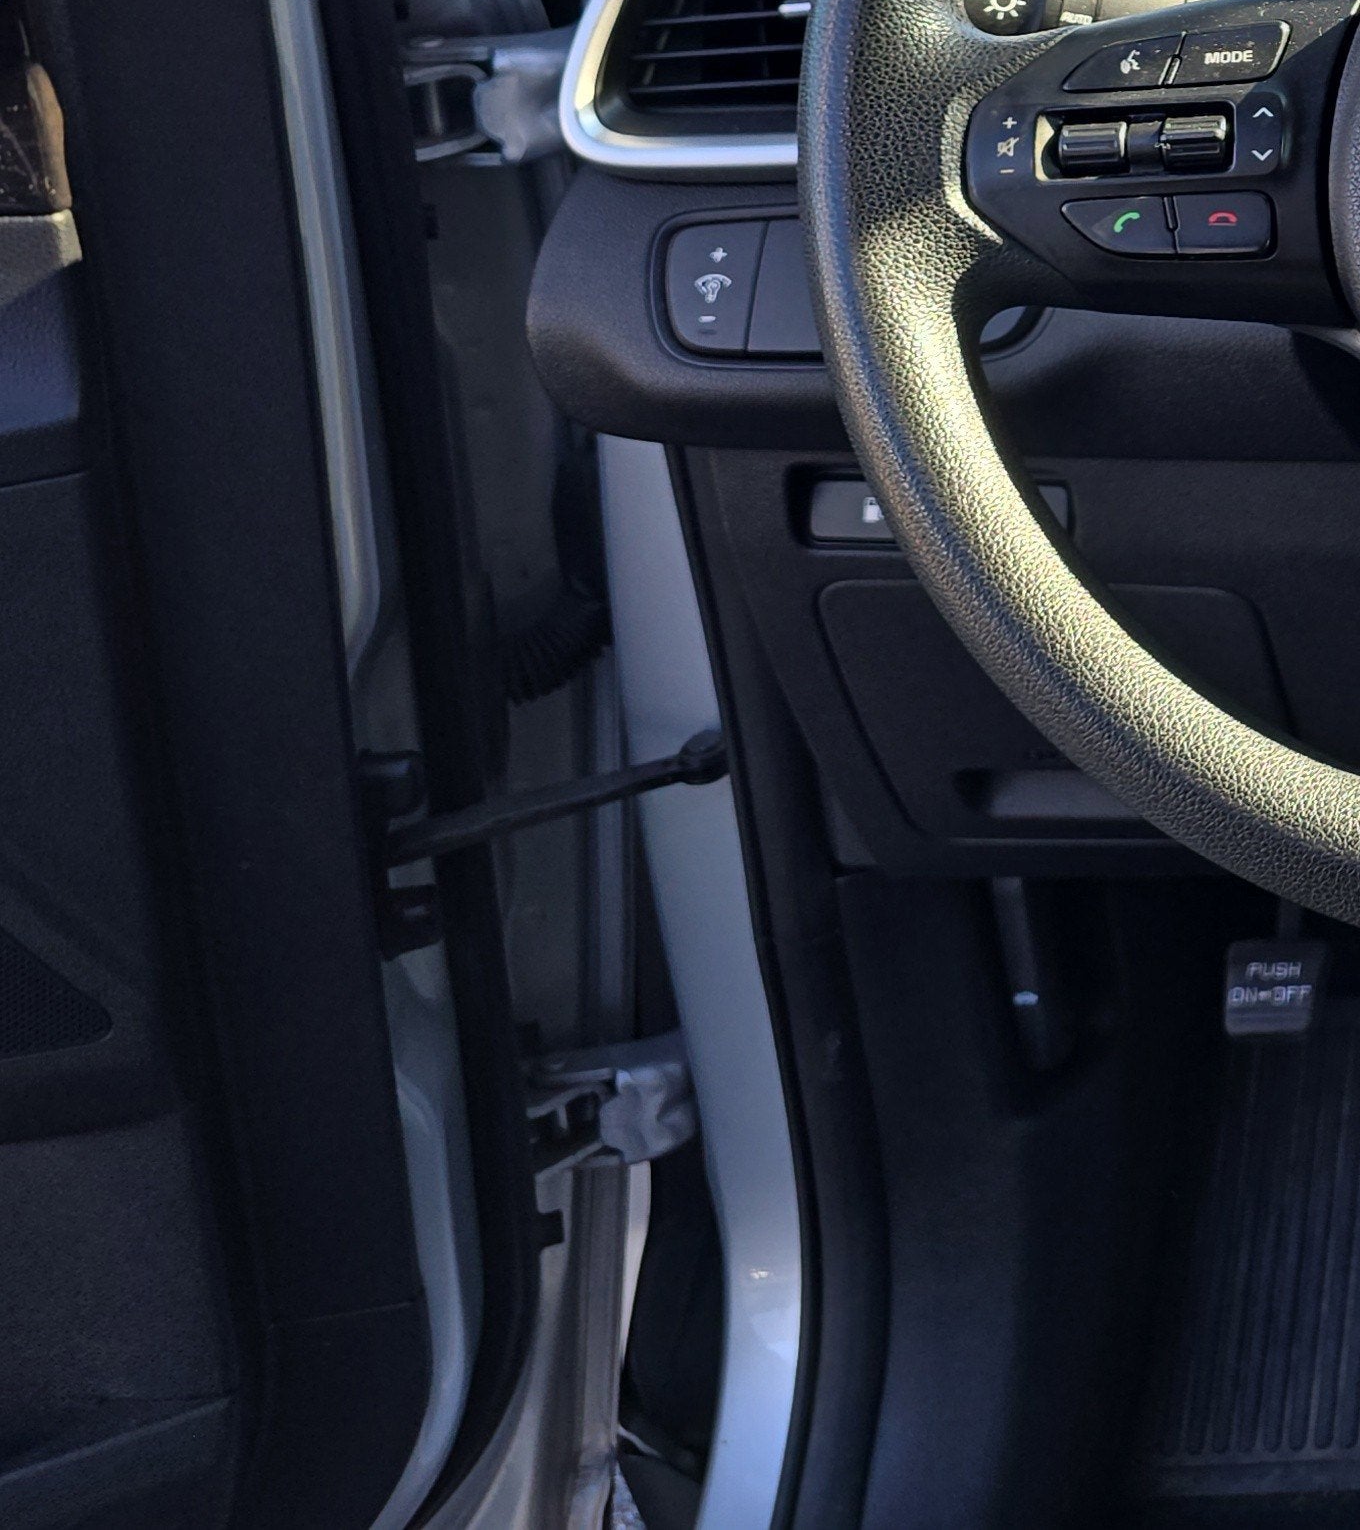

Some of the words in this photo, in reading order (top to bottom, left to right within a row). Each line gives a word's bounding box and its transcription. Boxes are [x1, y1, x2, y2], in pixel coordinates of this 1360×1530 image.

[1204, 49, 1254, 65] MODE
[1245, 961, 1302, 981] PUSH
[1228, 984, 1312, 1006] ON-OFF
